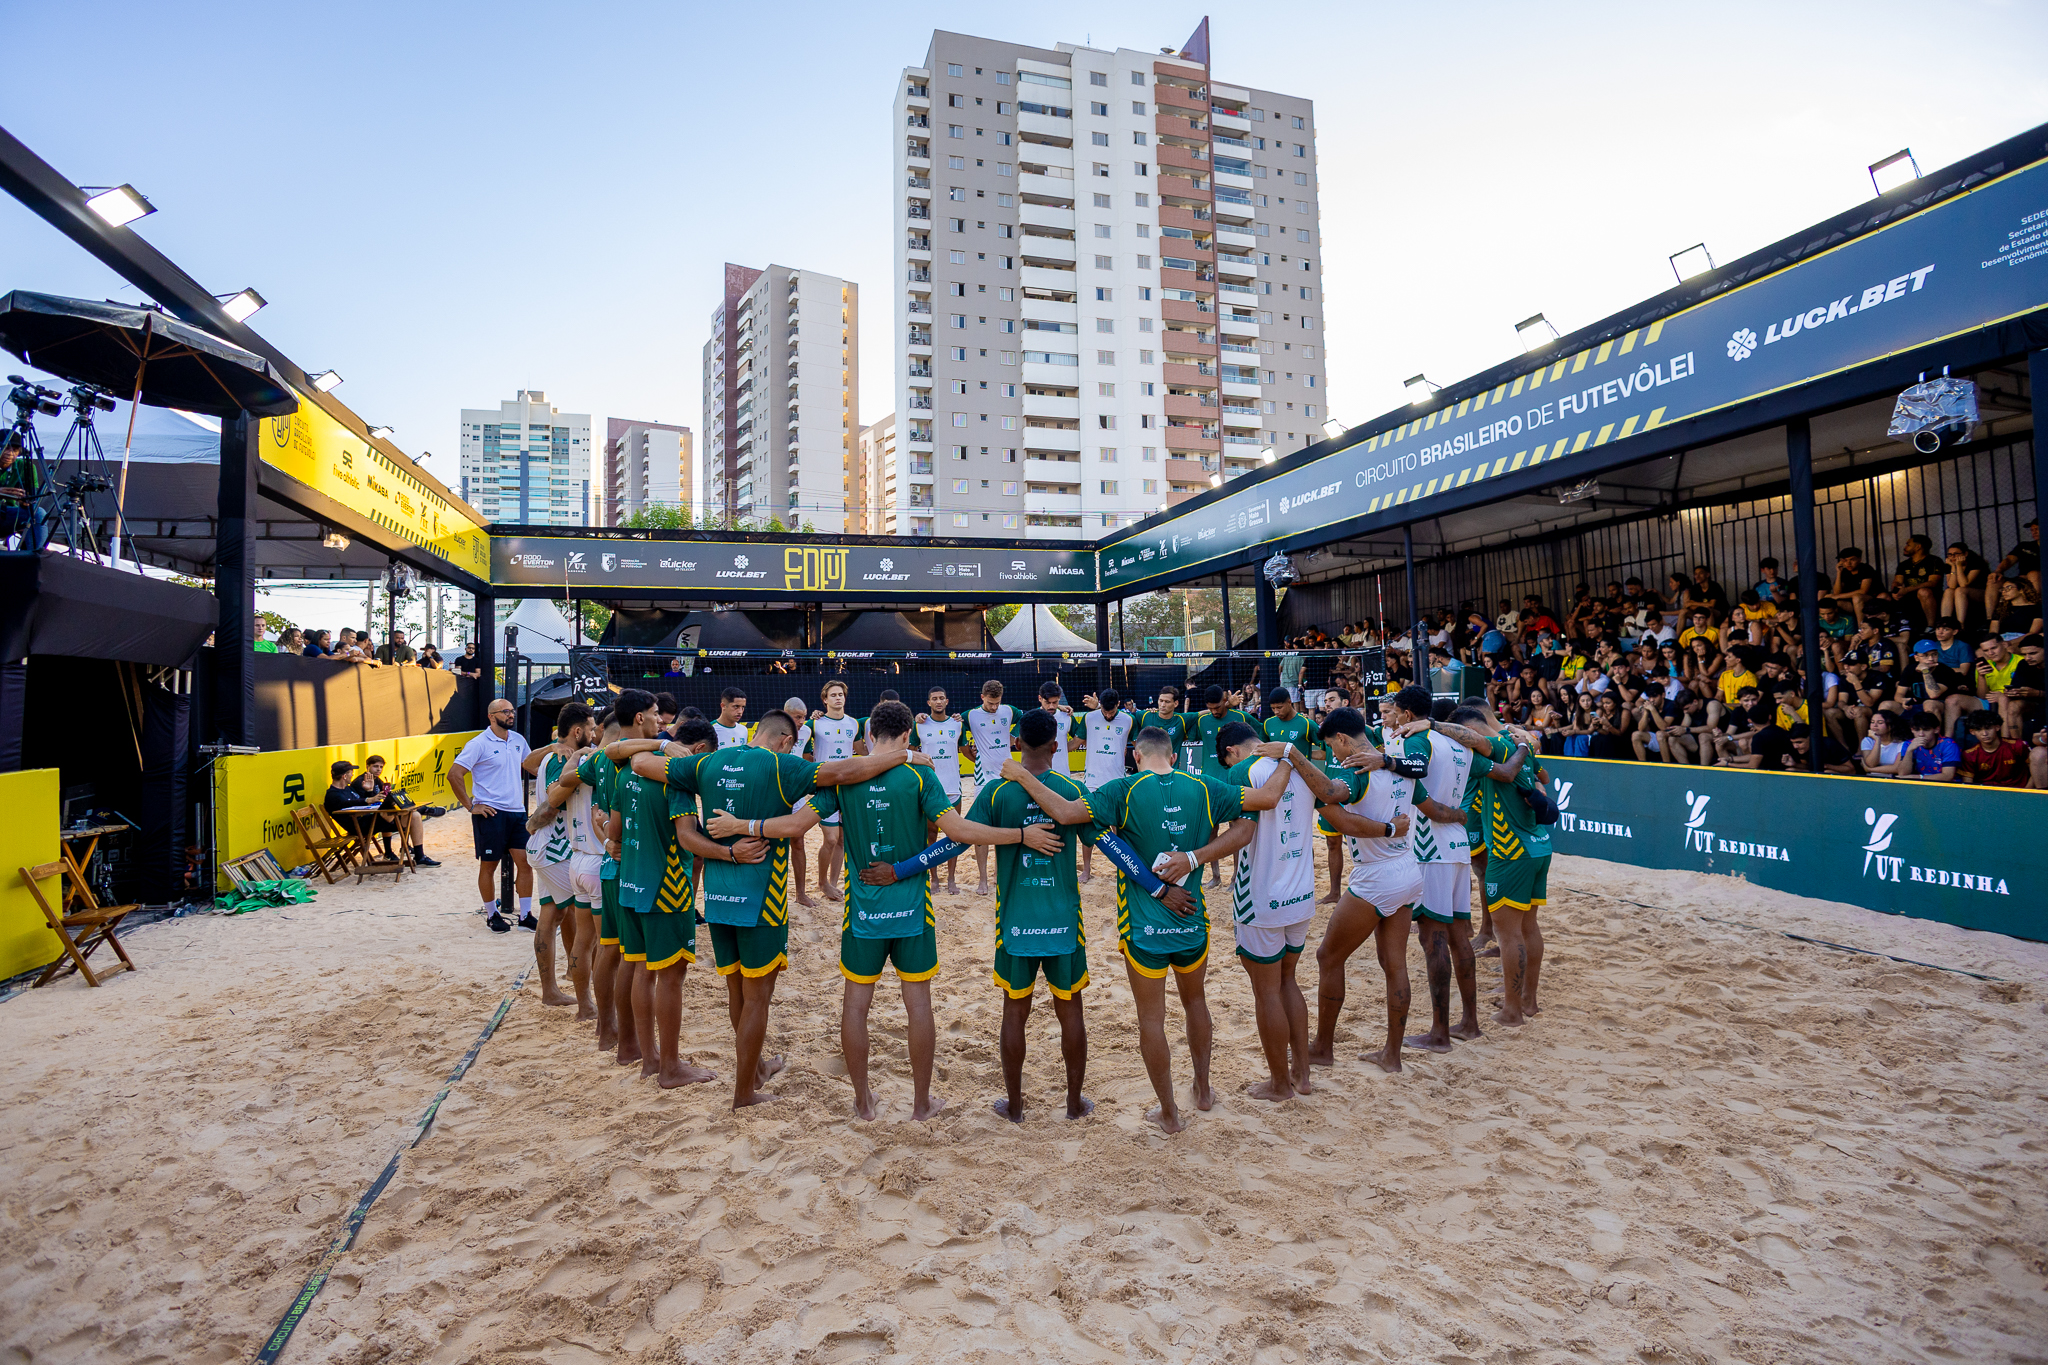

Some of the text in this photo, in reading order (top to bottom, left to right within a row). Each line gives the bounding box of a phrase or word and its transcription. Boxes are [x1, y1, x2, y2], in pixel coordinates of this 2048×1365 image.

[2008, 220, 2048, 240] Secretari
[1999, 245, 2010, 253] de
[2010, 234, 2041, 249] Estado
[1981, 239, 2048, 269] Desenvolviment
[2008, 248, 2048, 267] Econômic
[1763, 263, 1936, 346] LUCK.BET
[1355, 351, 1695, 488] CIRCUITO BRASILEIRO DE FUTEVÔLEI
[1290, 480, 1343, 509] LUCK.BET
[715, 570, 767, 578] LUCK.BET
[863, 573, 911, 581] LUCK.BET
[999, 571, 1038, 580] five athletic
[584, 677, 602, 687] CT
[1372, 672, 1384, 681] CT
[400, 772, 425, 788] EVERTON
[263, 819, 285, 844] five
[1579, 818, 1633, 838] REDINHA
[928, 847, 944, 859] MEU
[1108, 840, 1140, 876] five athletic
[1718, 838, 1790, 862] REDINHA
[1909, 865, 2010, 896] REDINHA
[708, 893, 748, 903] LUCK.BET
[1281, 891, 1314, 907] LUCK.BET
[868, 909, 915, 920] LUCK.BET
[1022, 926, 1069, 935] LUCK.BET
[268, 1275, 325, 1351] CIRCUITO BRASILEIRO
